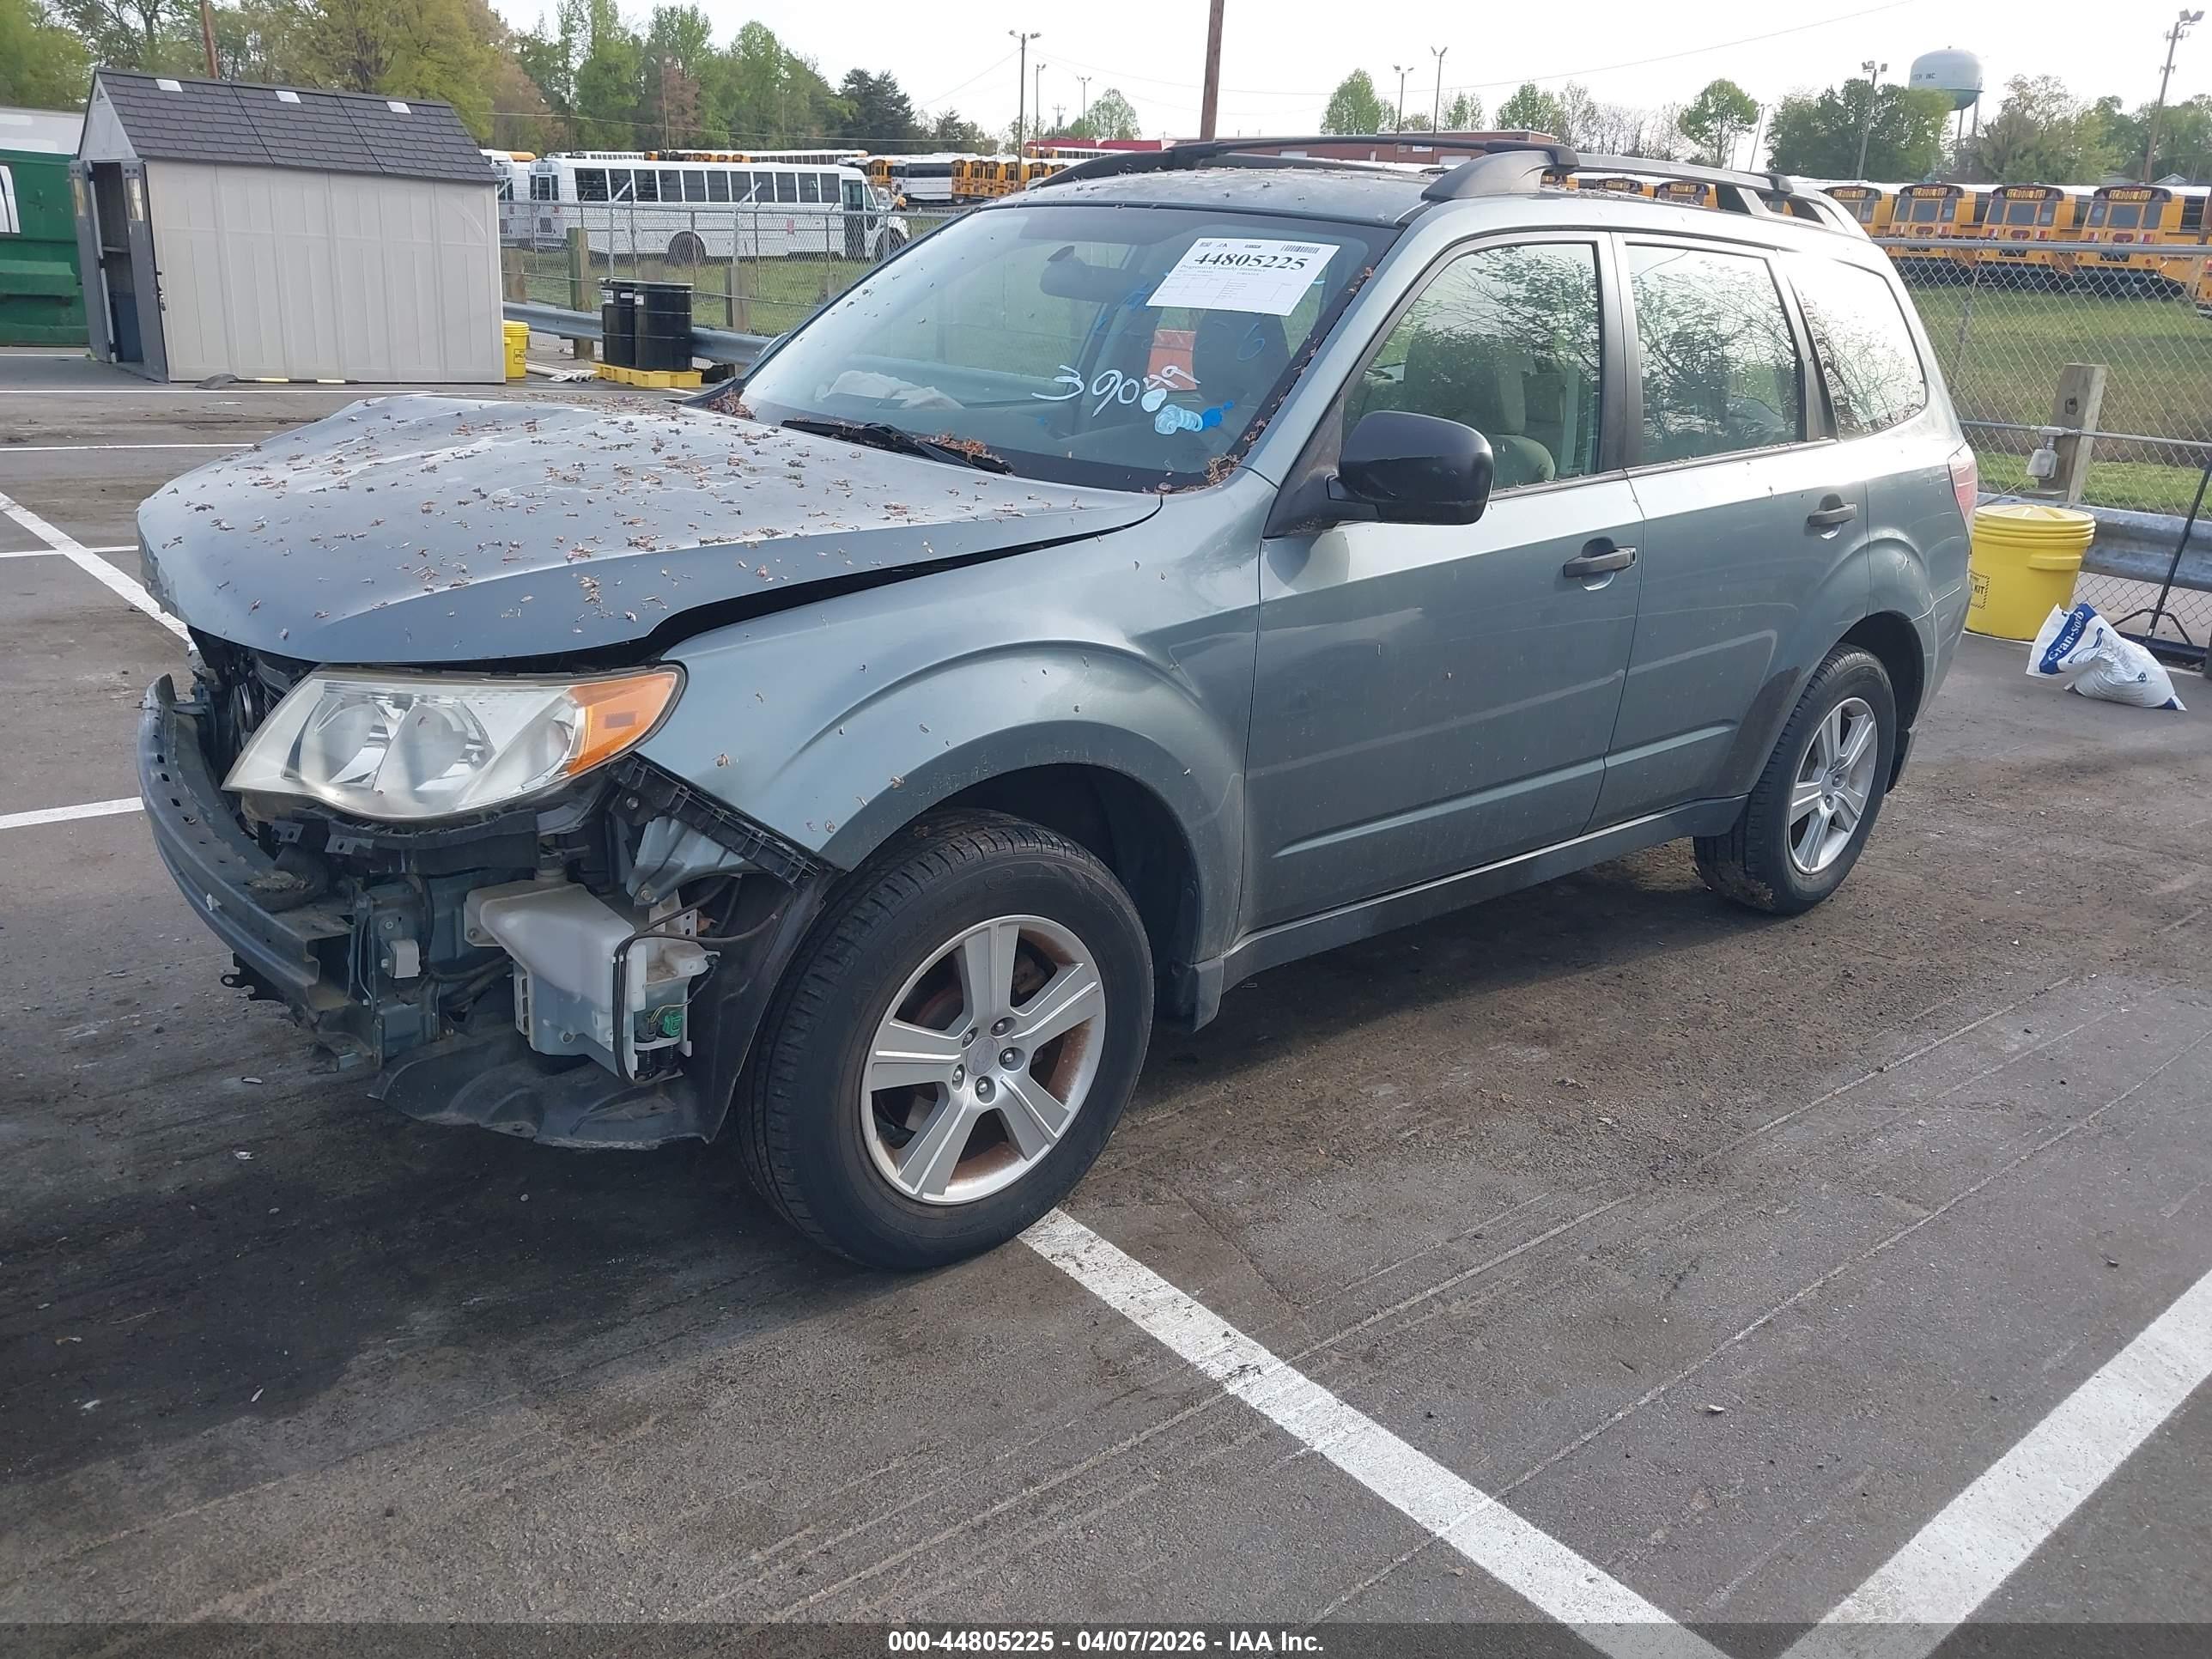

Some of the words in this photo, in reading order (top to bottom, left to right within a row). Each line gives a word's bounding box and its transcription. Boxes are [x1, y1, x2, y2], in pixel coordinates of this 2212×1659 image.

[1194, 252, 1309, 270] 44805225
[1975, 584, 1985, 594] KIT
[2048, 610, 2085, 661] Gran-sorb
